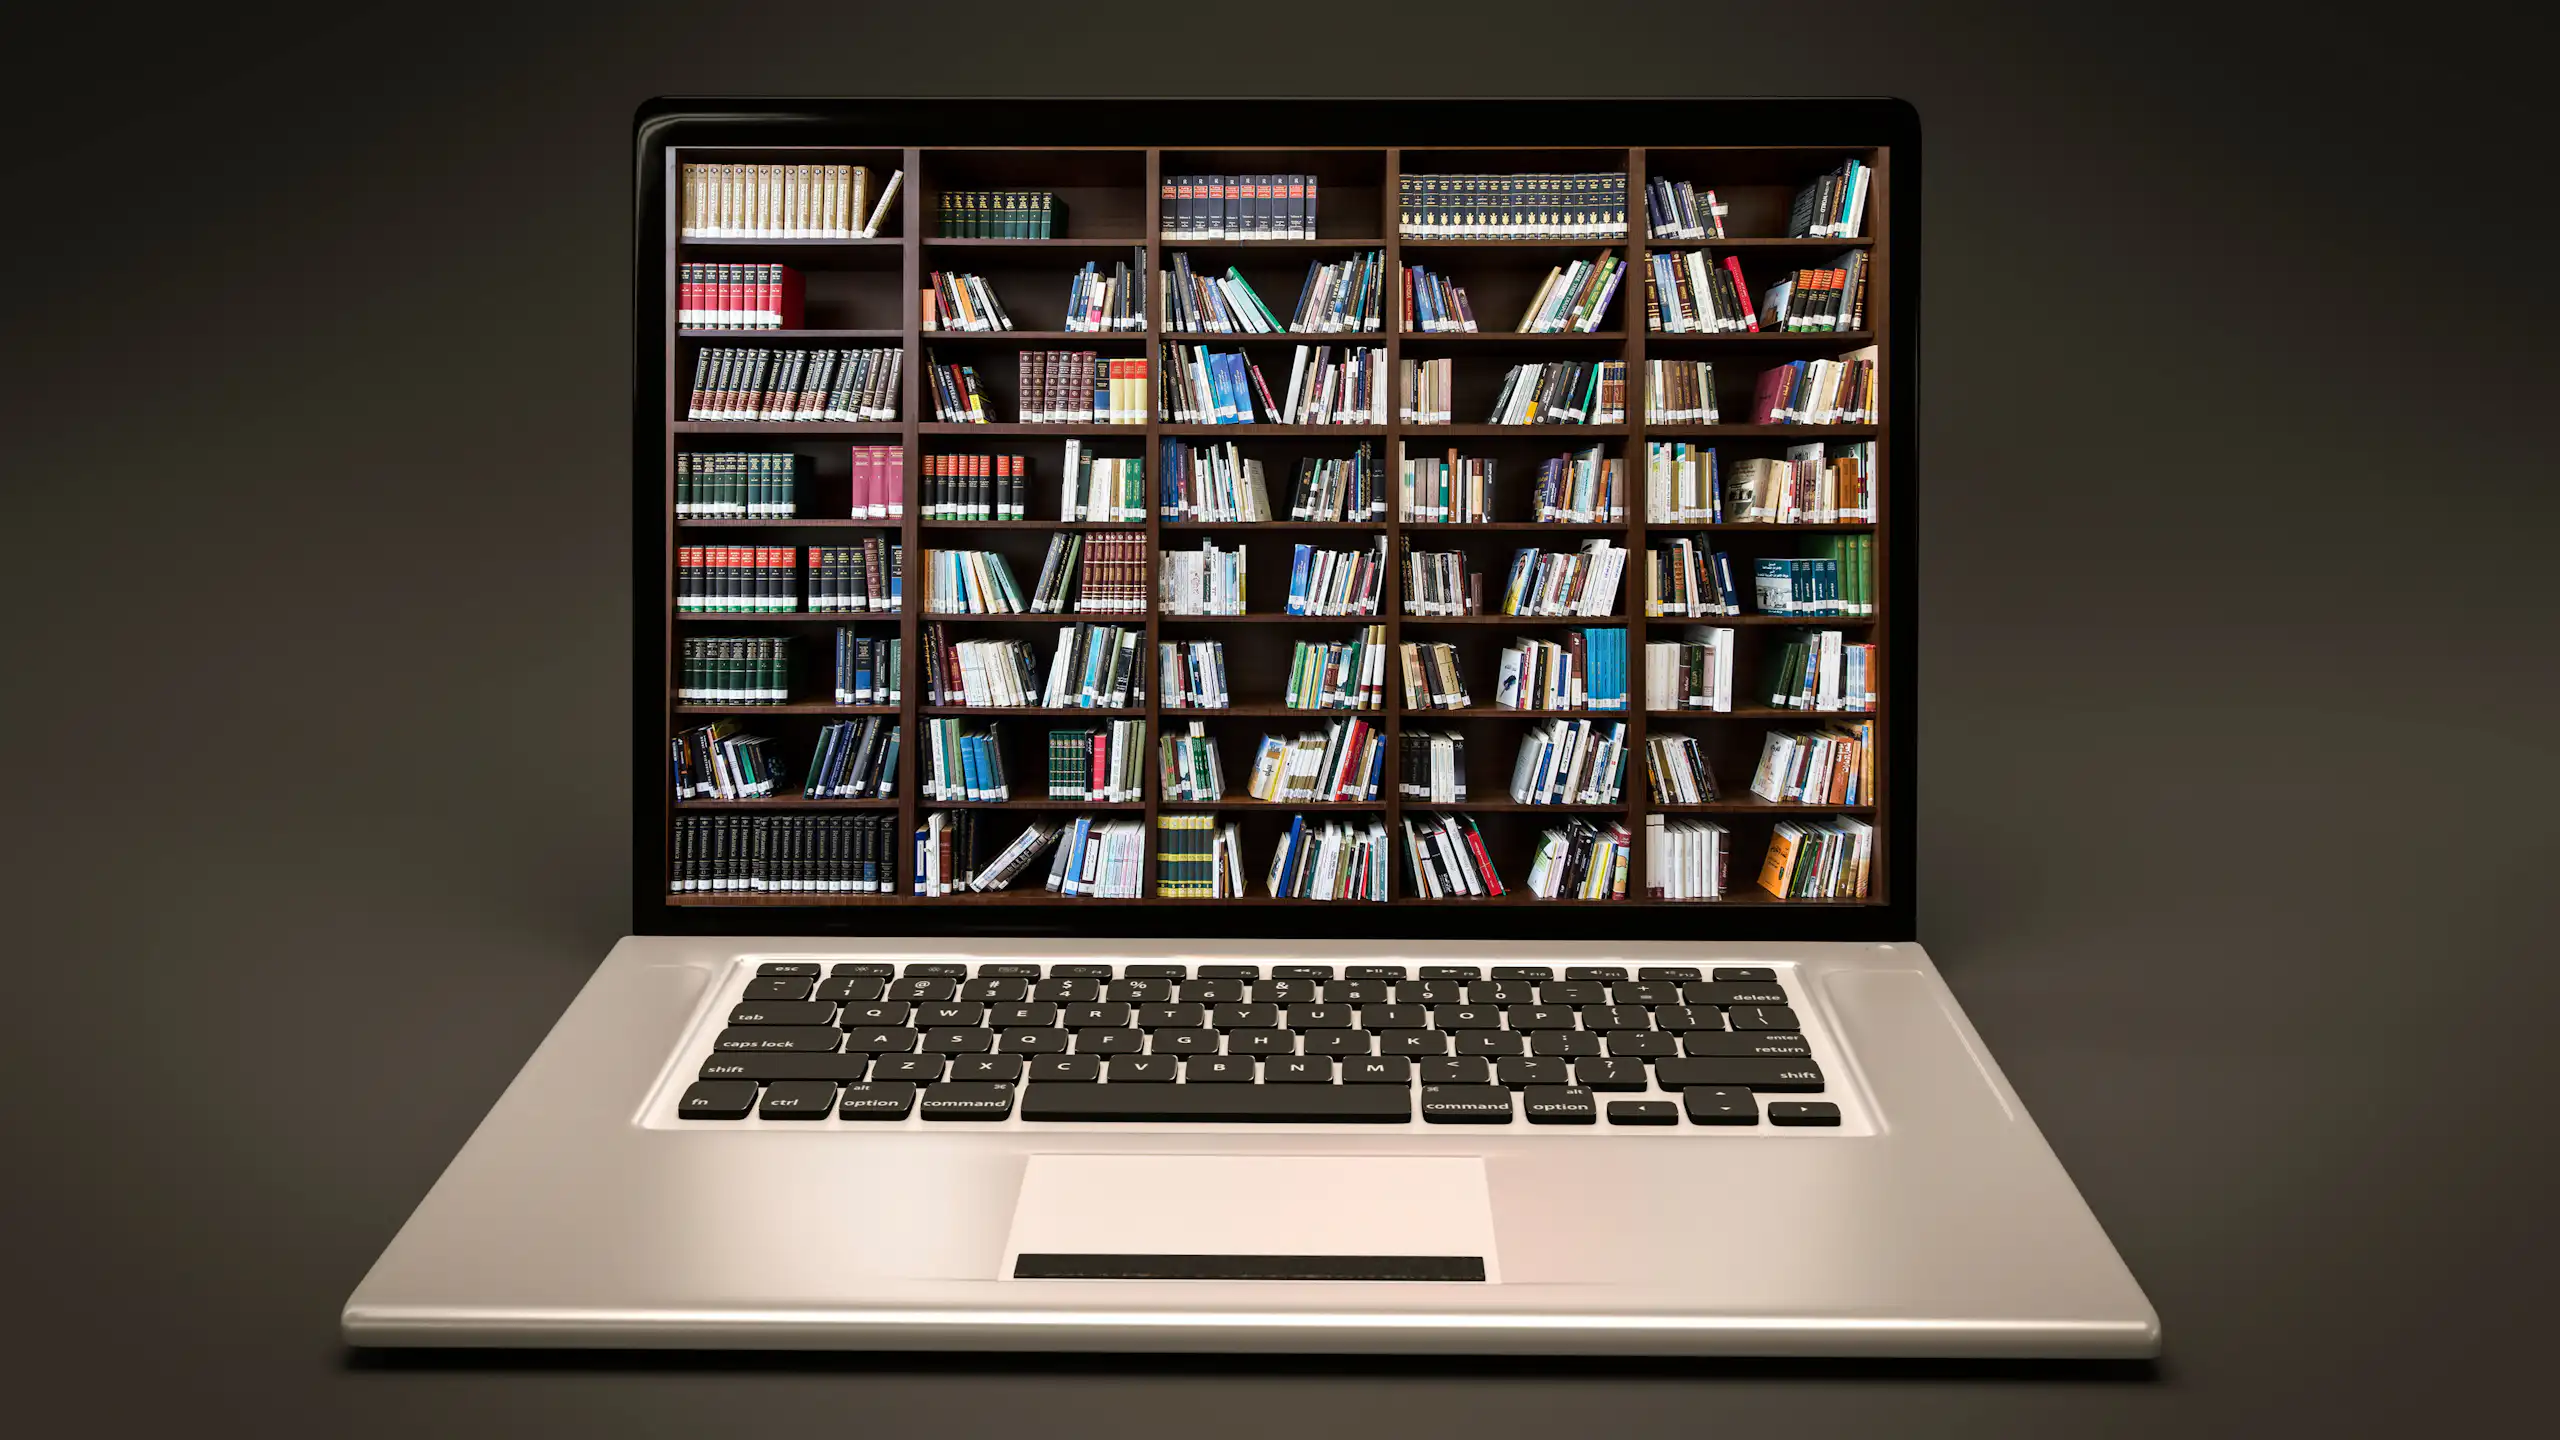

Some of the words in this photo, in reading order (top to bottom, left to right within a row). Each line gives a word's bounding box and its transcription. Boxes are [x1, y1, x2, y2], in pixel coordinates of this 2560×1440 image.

[1332, 278, 1341, 299] DUBAI
[1327, 300, 1336, 316] CITY
[847, 979, 855, 988] !
[914, 980, 931, 989] @
[989, 980, 1000, 989] #
[1061, 979, 1073, 990] $
[1129, 980, 1148, 989] %
[1275, 981, 1289, 990] &
[912, 989, 925, 997] 2
[985, 989, 997, 997] 3
[1131, 990, 1142, 998] 5
[1276, 991, 1288, 999] 7
[1349, 991, 1361, 999] 8
[1495, 992, 1507, 1000] 0
[738, 1013, 764, 1021] tab
[866, 1009, 882, 1018] Q
[939, 1009, 959, 1017] W
[1016, 1009, 1028, 1018] E
[1089, 1010, 1102, 1018] R
[1164, 1010, 1177, 1018] T
[1237, 1011, 1251, 1019] Y
[1311, 1011, 1325, 1019] U
[1389, 1011, 1395, 1019] I
[1459, 1012, 1475, 1020] O
[1535, 1012, 1548, 1020] P
[873, 1034, 888, 1043] A
[950, 1035, 963, 1043] S
[1020, 1035, 1037, 1044] Q
[1102, 1035, 1114, 1044] F
[1176, 1036, 1192, 1044] G
[1254, 1036, 1269, 1045] H
[1331, 1037, 1341, 1045] J
[1407, 1037, 1420, 1045] K
[1483, 1037, 1495, 1046] L
[723, 1041, 758, 1050] caps
[761, 1040, 794, 1048] lock
[900, 1061, 916, 1070] Z
[978, 1062, 993, 1070] X
[1057, 1062, 1071, 1071] C
[1134, 1063, 1149, 1071] V
[1213, 1063, 1226, 1072] B
[1290, 1063, 1305, 1072] N
[1366, 1064, 1385, 1072] M
[1604, 1060, 1614, 1069] ?
[707, 1065, 744, 1073] shift
[1780, 1071, 1817, 1079] shift
[691, 1098, 709, 1106] fn
[770, 1098, 799, 1106] ctrl
[843, 1099, 899, 1108] option
[922, 1099, 1007, 1108] command
[1425, 1102, 1509, 1110] command
[1532, 1103, 1589, 1112] option
